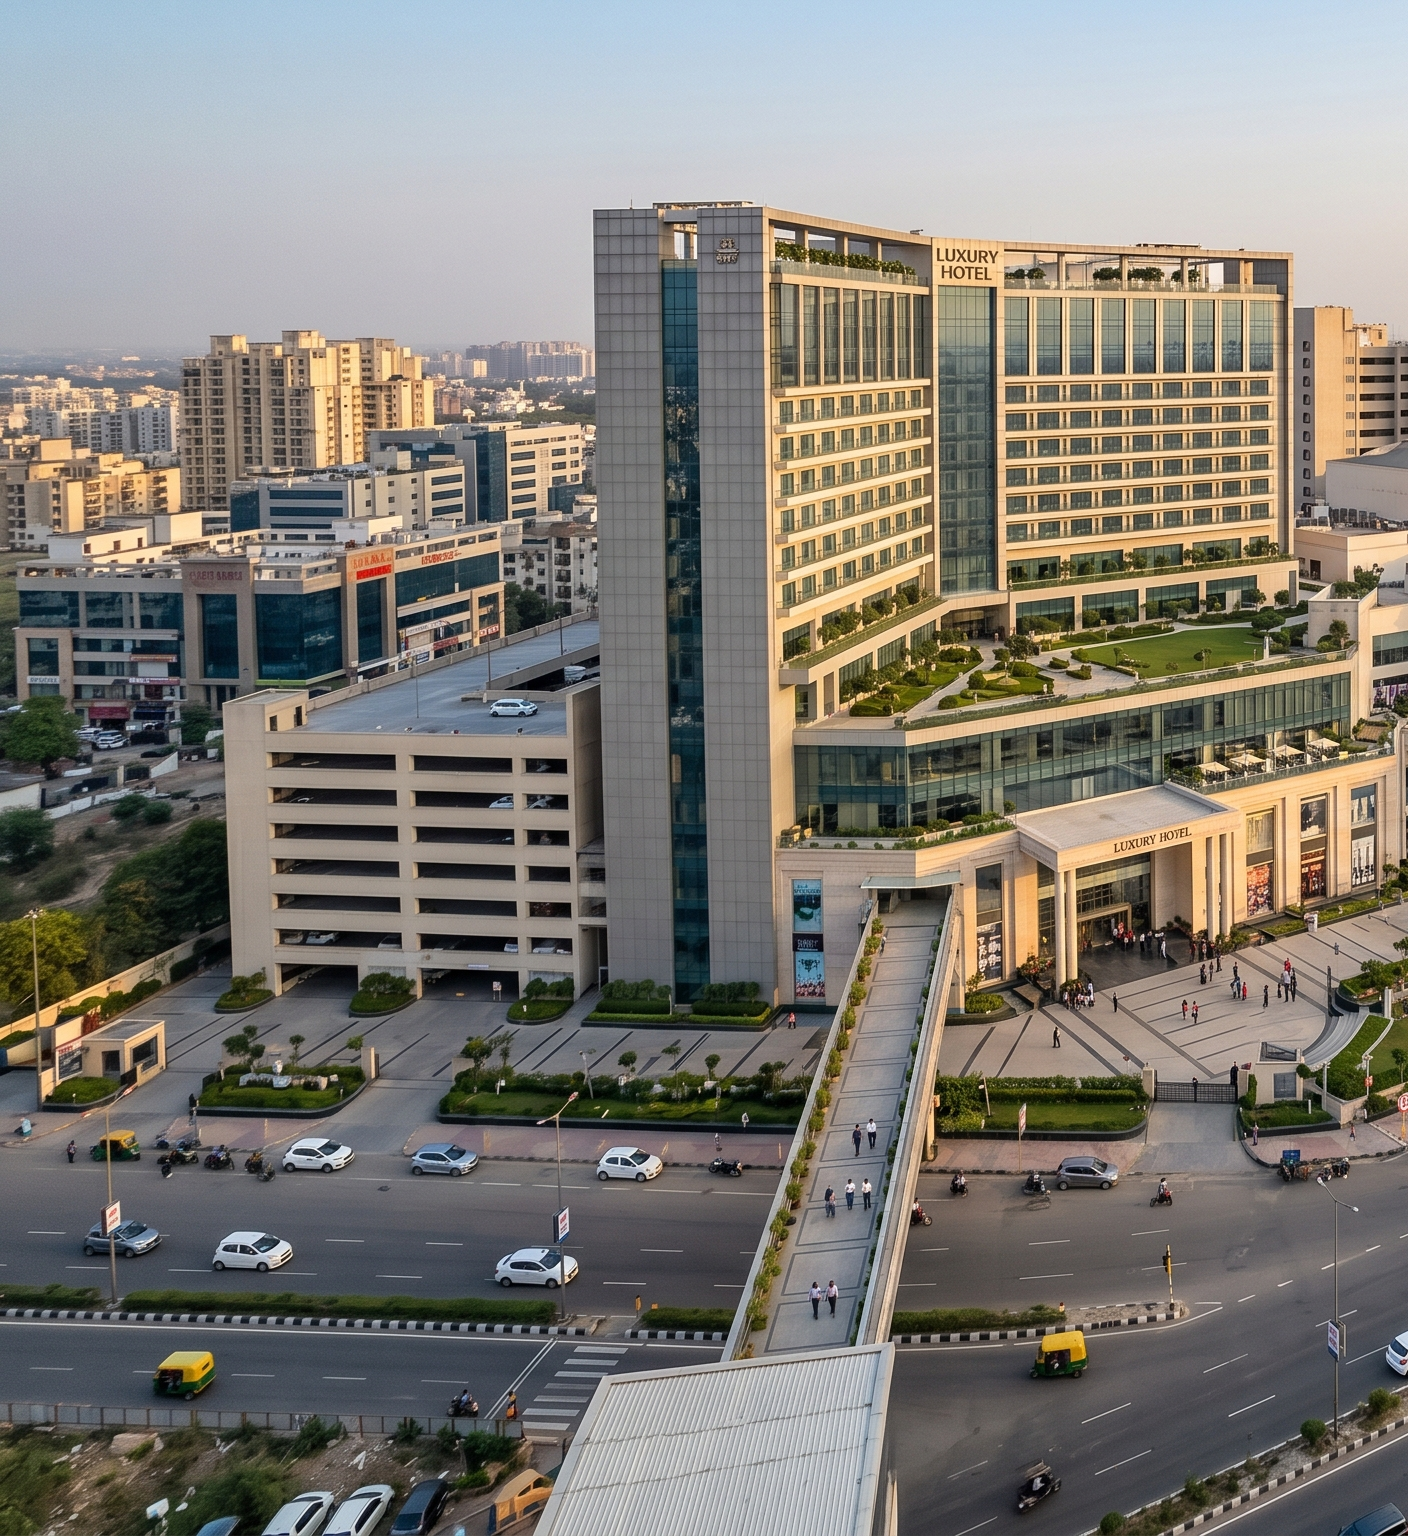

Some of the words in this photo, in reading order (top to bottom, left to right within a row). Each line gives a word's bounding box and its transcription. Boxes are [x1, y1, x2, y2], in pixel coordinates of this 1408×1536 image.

[936, 247, 999, 264] LUXURY
[941, 265, 992, 280] HOTEL
[1113, 834, 1157, 853] LUXURY
